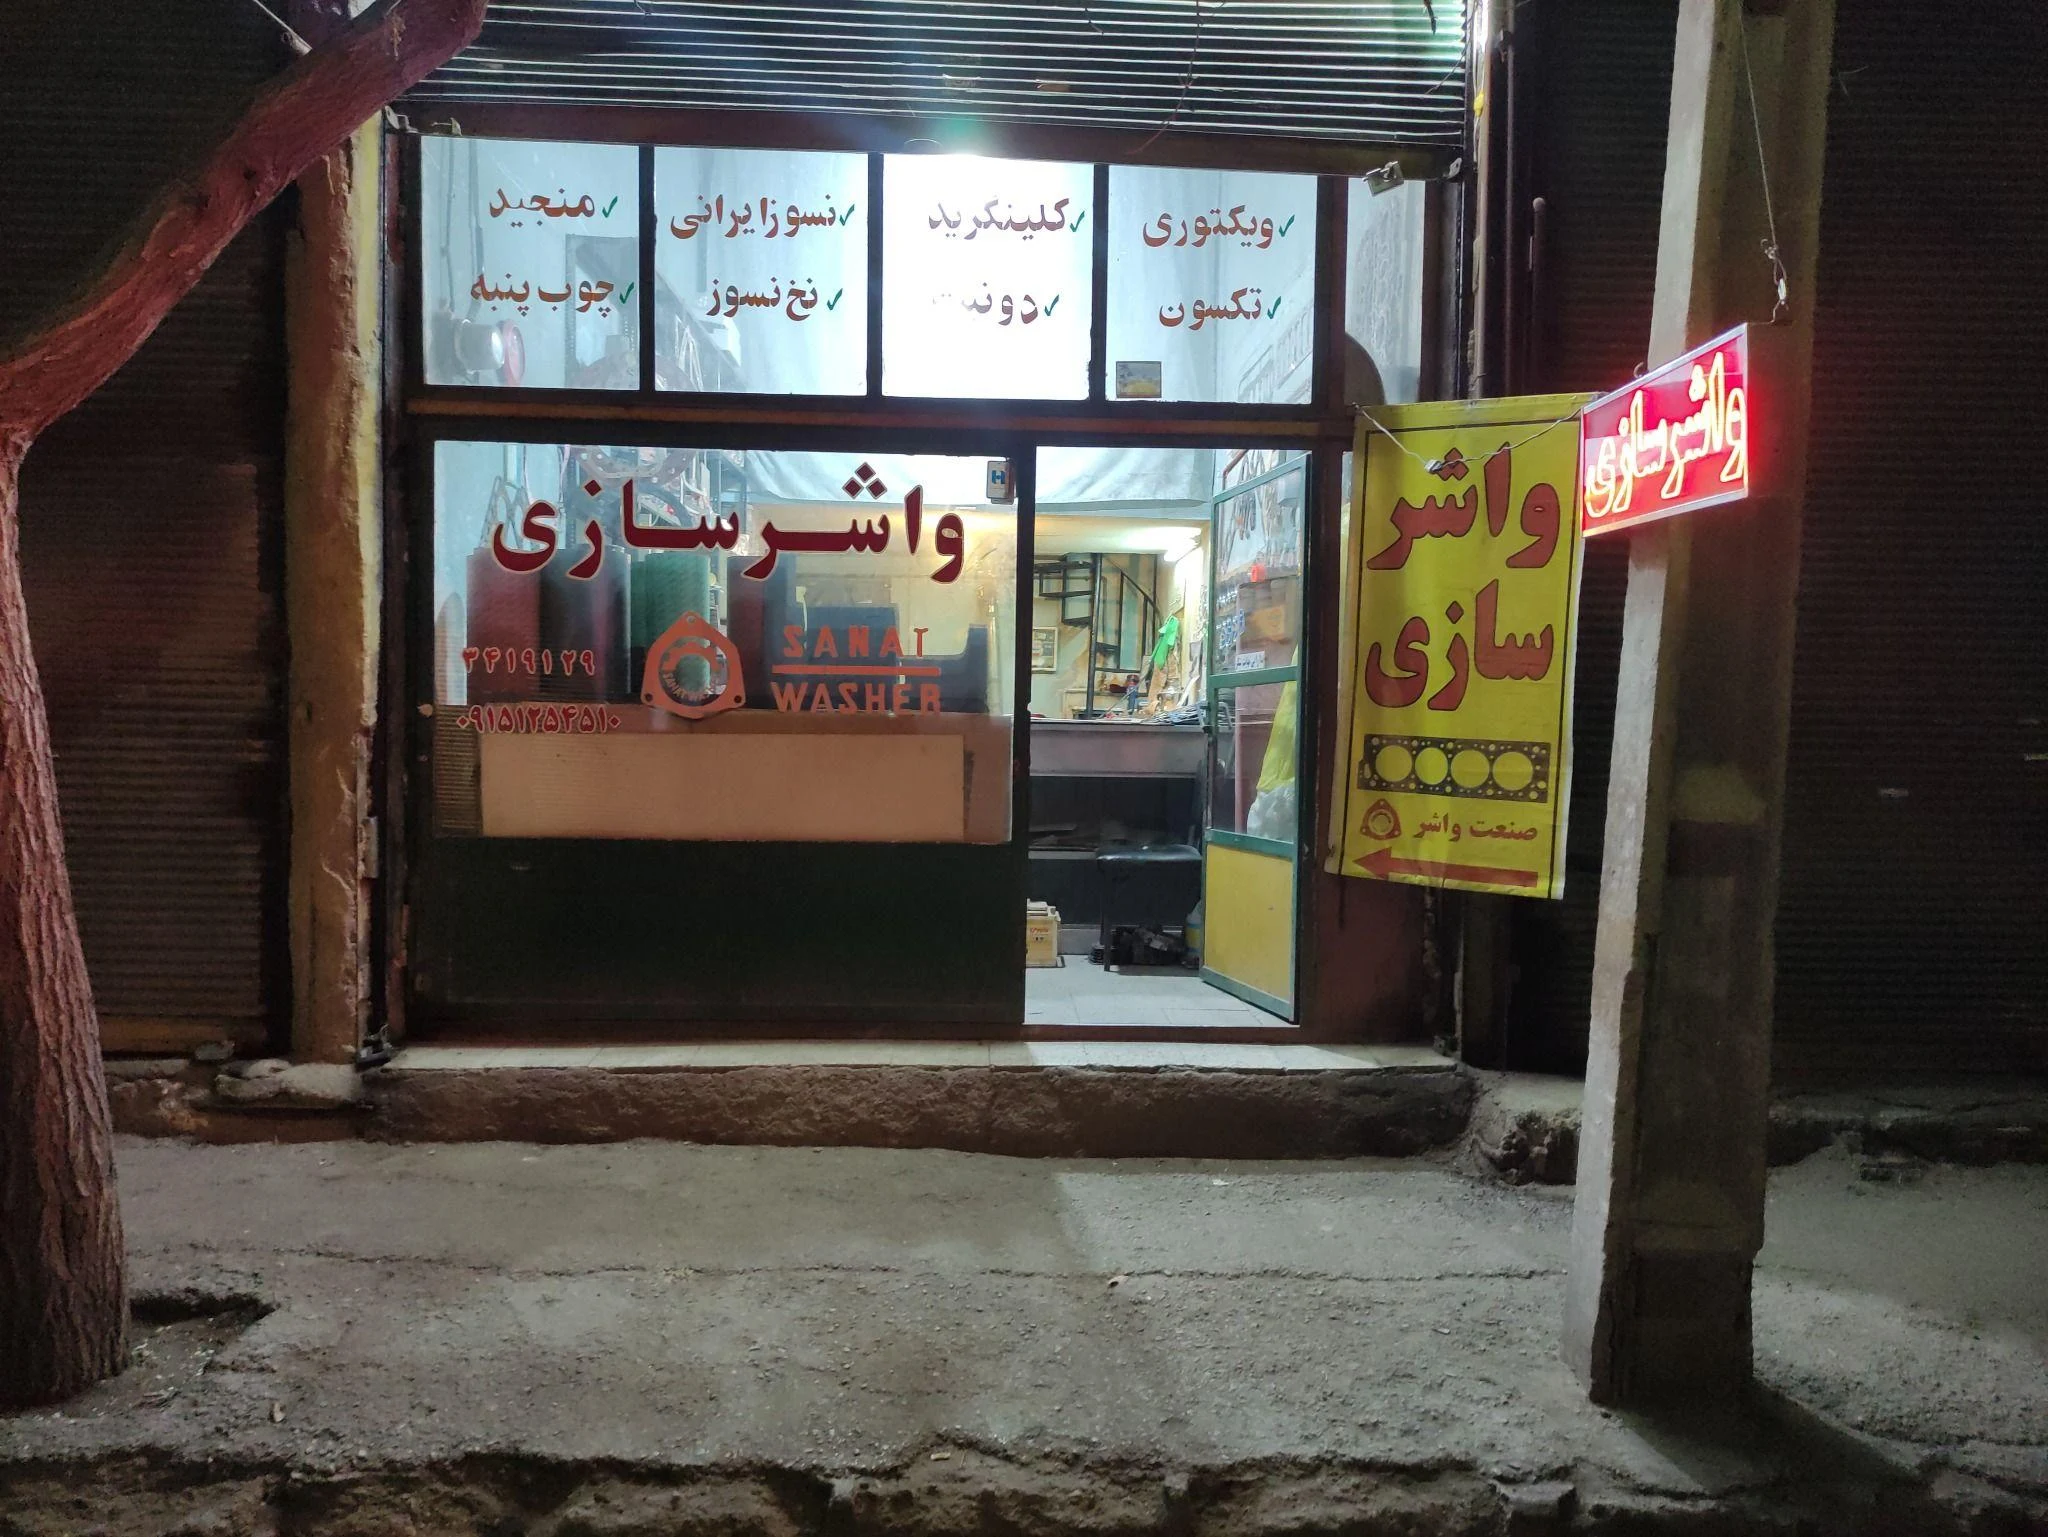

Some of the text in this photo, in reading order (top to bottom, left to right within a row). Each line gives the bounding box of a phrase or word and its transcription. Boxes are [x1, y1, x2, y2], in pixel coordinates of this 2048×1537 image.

[489, 187, 596, 228] منجید
[1142, 204, 1274, 248] ویکتوری
[470, 272, 615, 319] چوب پنبه
[706, 276, 818, 321] نخ نسوز
[1158, 287, 1262, 330] تکسون
[1366, 441, 1561, 569] واشر
[783, 624, 929, 658] SANAT
[1365, 578, 1554, 711] سازی
[456, 704, 622, 734] ۰۹۱۵۱۲۵۴۵۱۰
[769, 681, 942, 716] WASHER
[1412, 811, 1538, 842] صنعت واشر
